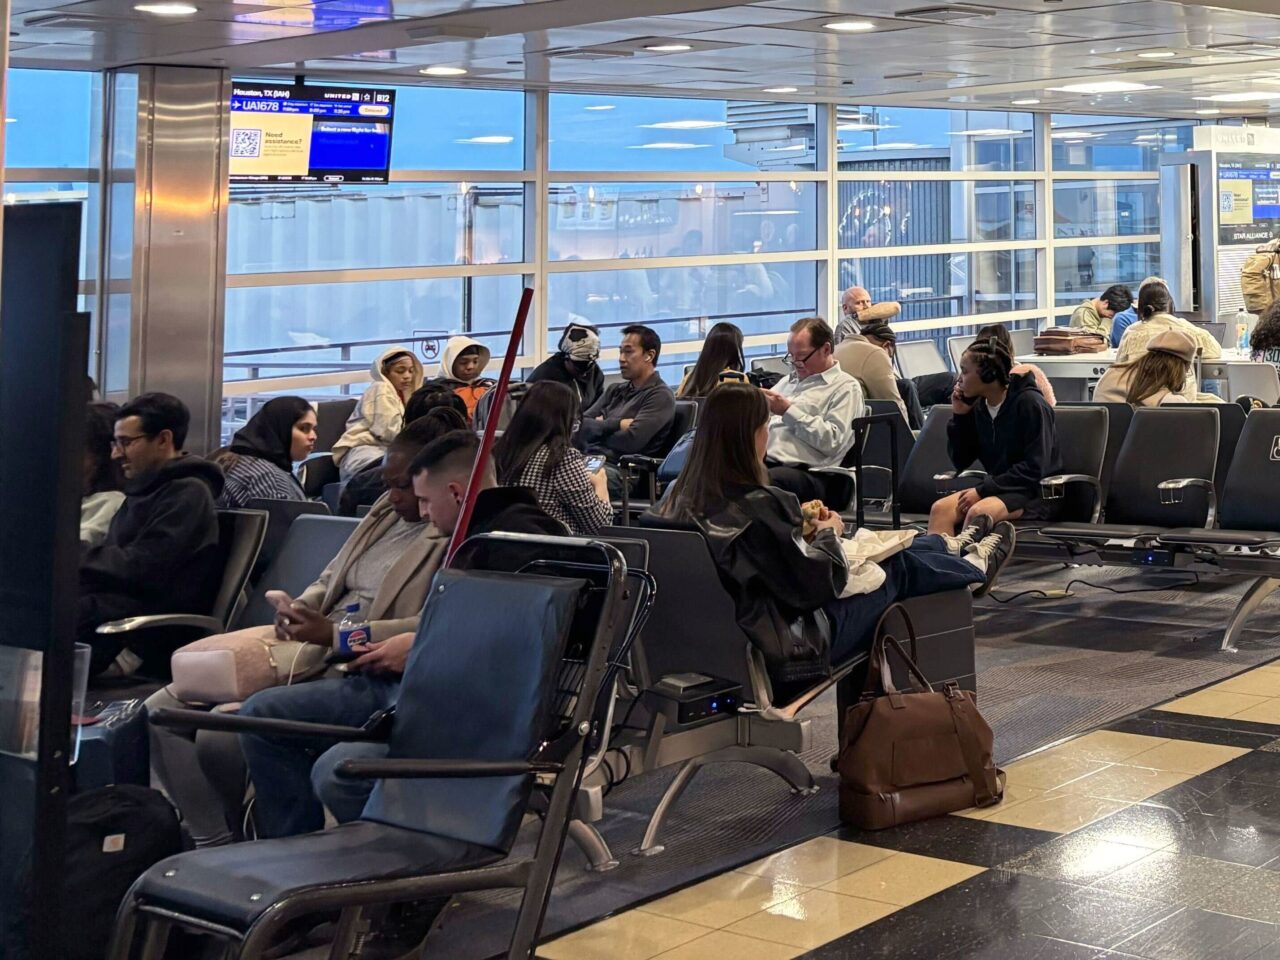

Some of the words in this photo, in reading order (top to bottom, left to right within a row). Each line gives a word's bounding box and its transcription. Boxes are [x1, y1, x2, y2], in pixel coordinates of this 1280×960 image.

[233, 88, 263, 98] Houston,
[263, 89, 273, 97] TX
[376, 94, 390, 102] B12
[242, 101, 279, 111] UA1678
[1233, 232, 1246, 240] STAR
[1246, 231, 1268, 239] ALLIANCE
